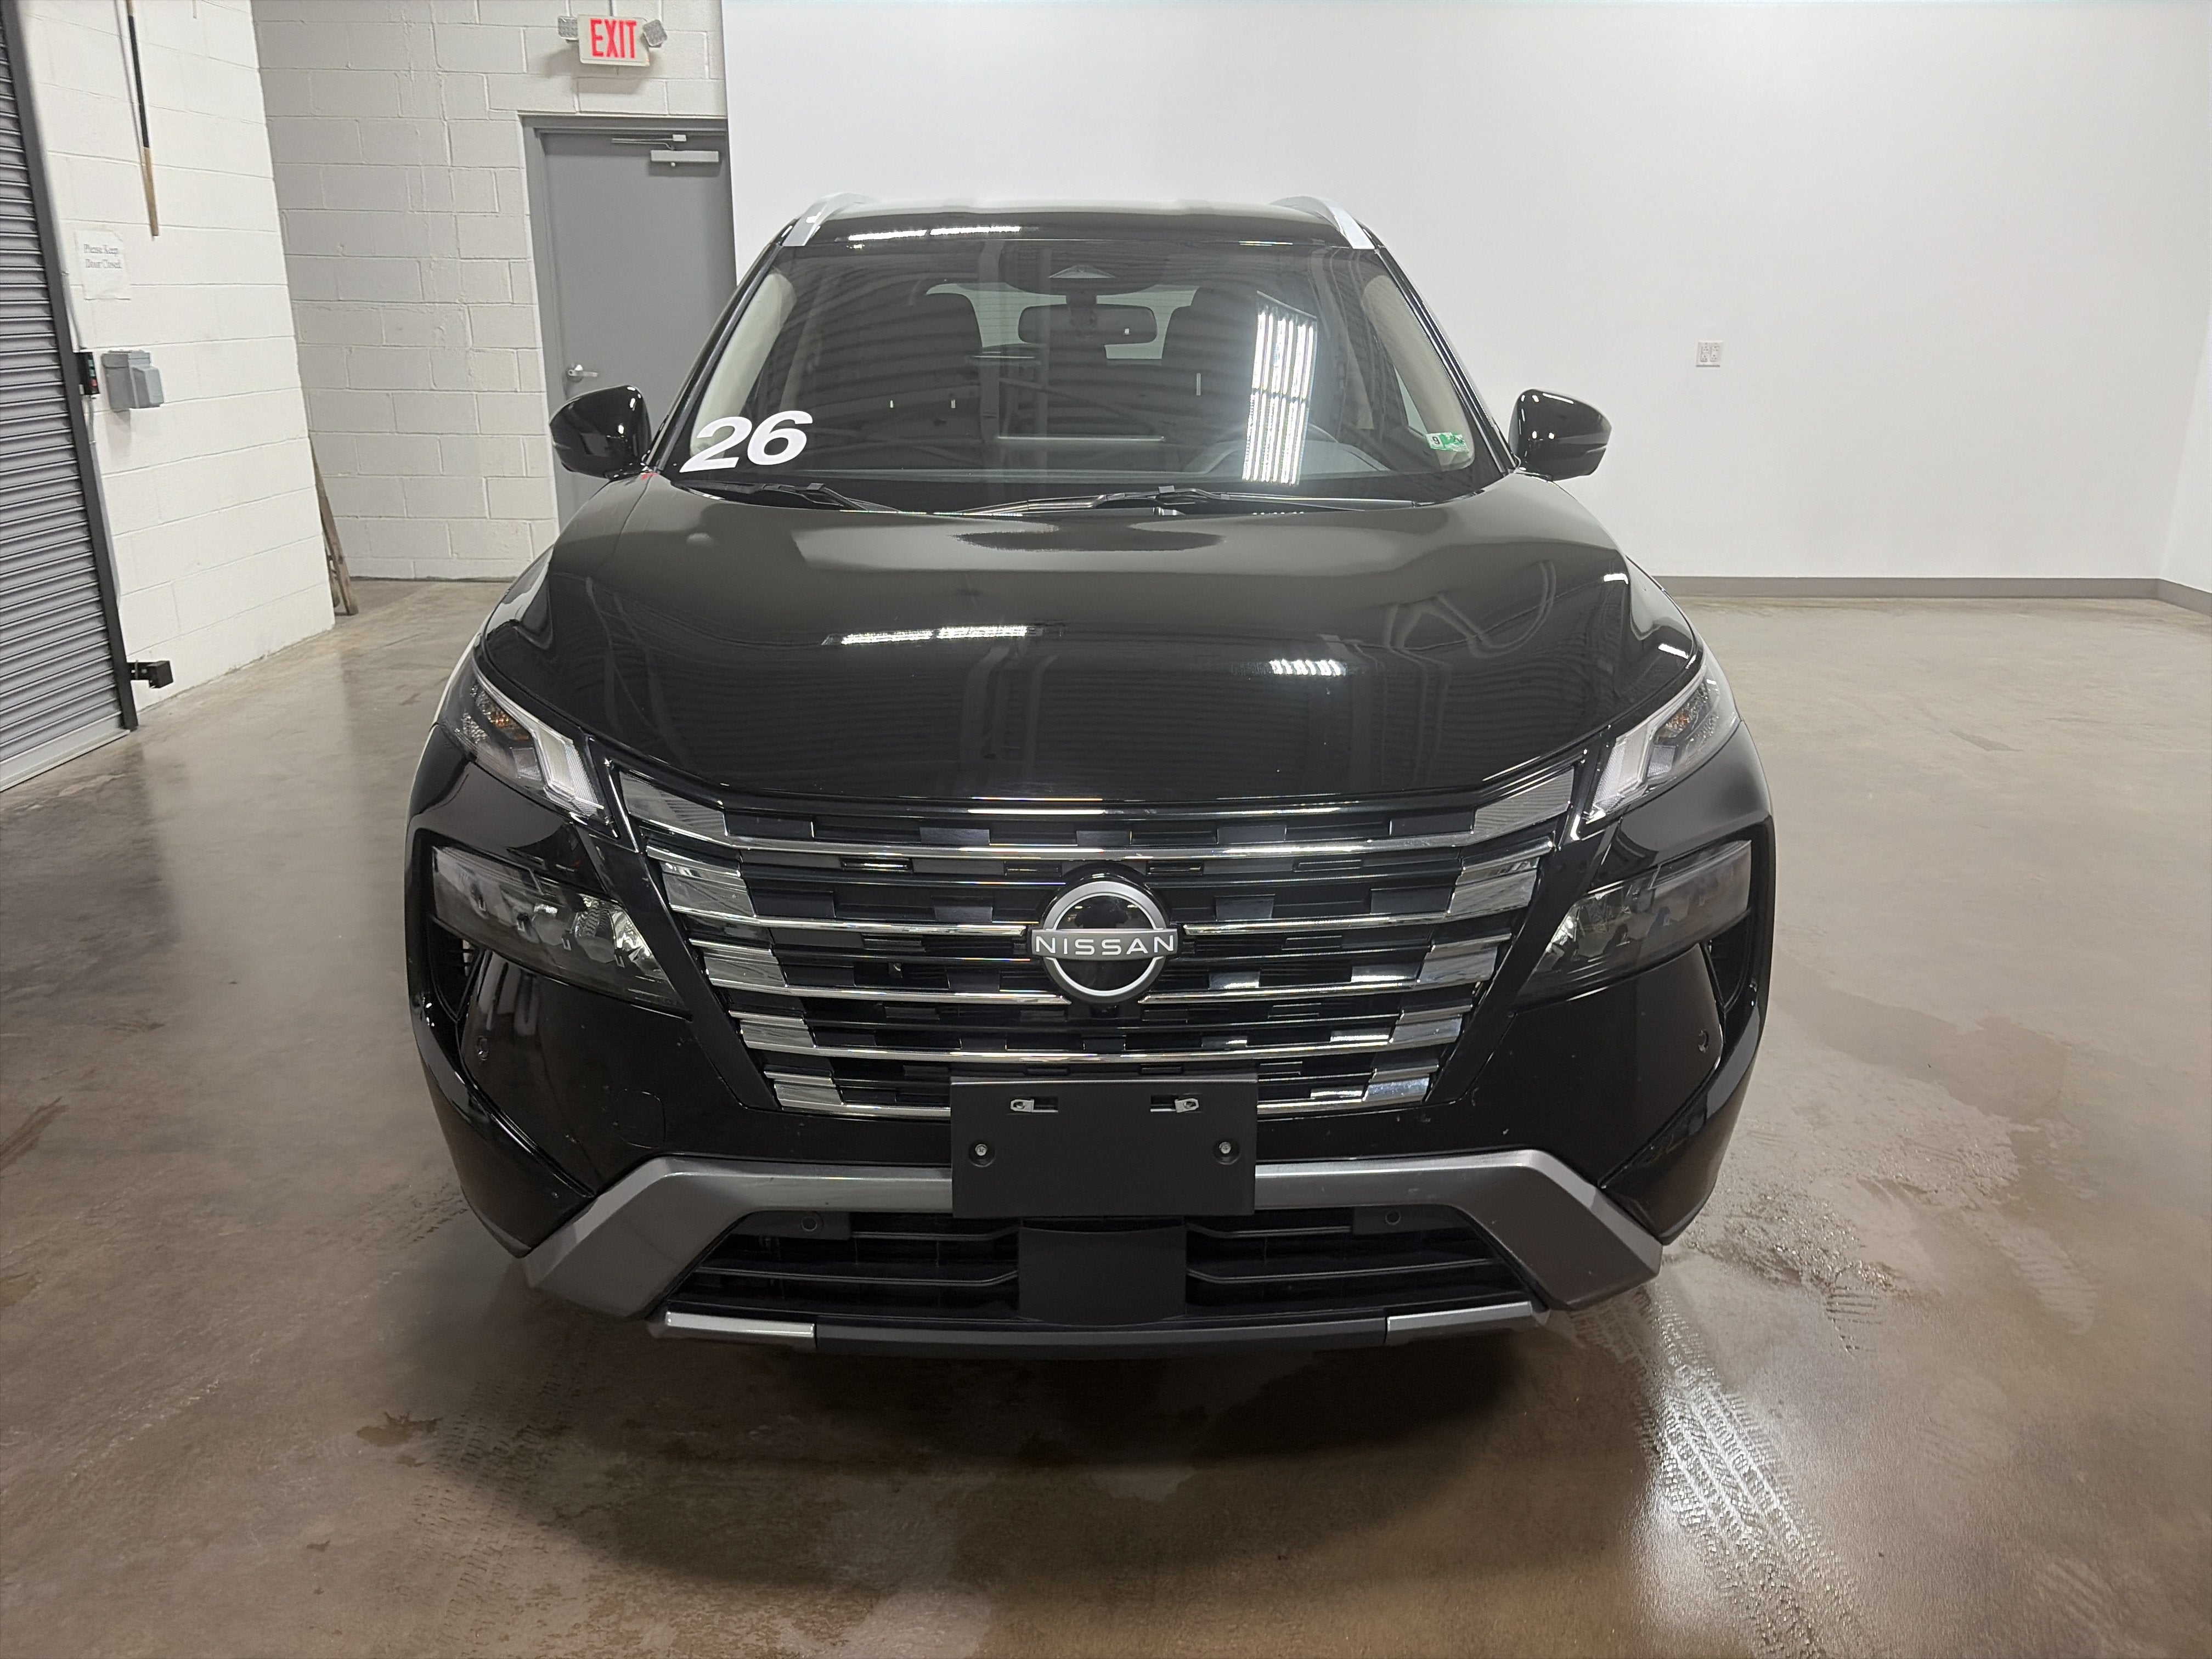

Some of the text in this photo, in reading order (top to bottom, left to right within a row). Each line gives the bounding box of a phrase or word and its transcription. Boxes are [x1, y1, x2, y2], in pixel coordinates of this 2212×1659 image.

[590, 19, 637, 58] EXIT
[679, 410, 813, 472] 26
[1432, 436, 1440, 445] 9
[1036, 935, 1173, 955] NISSAN
